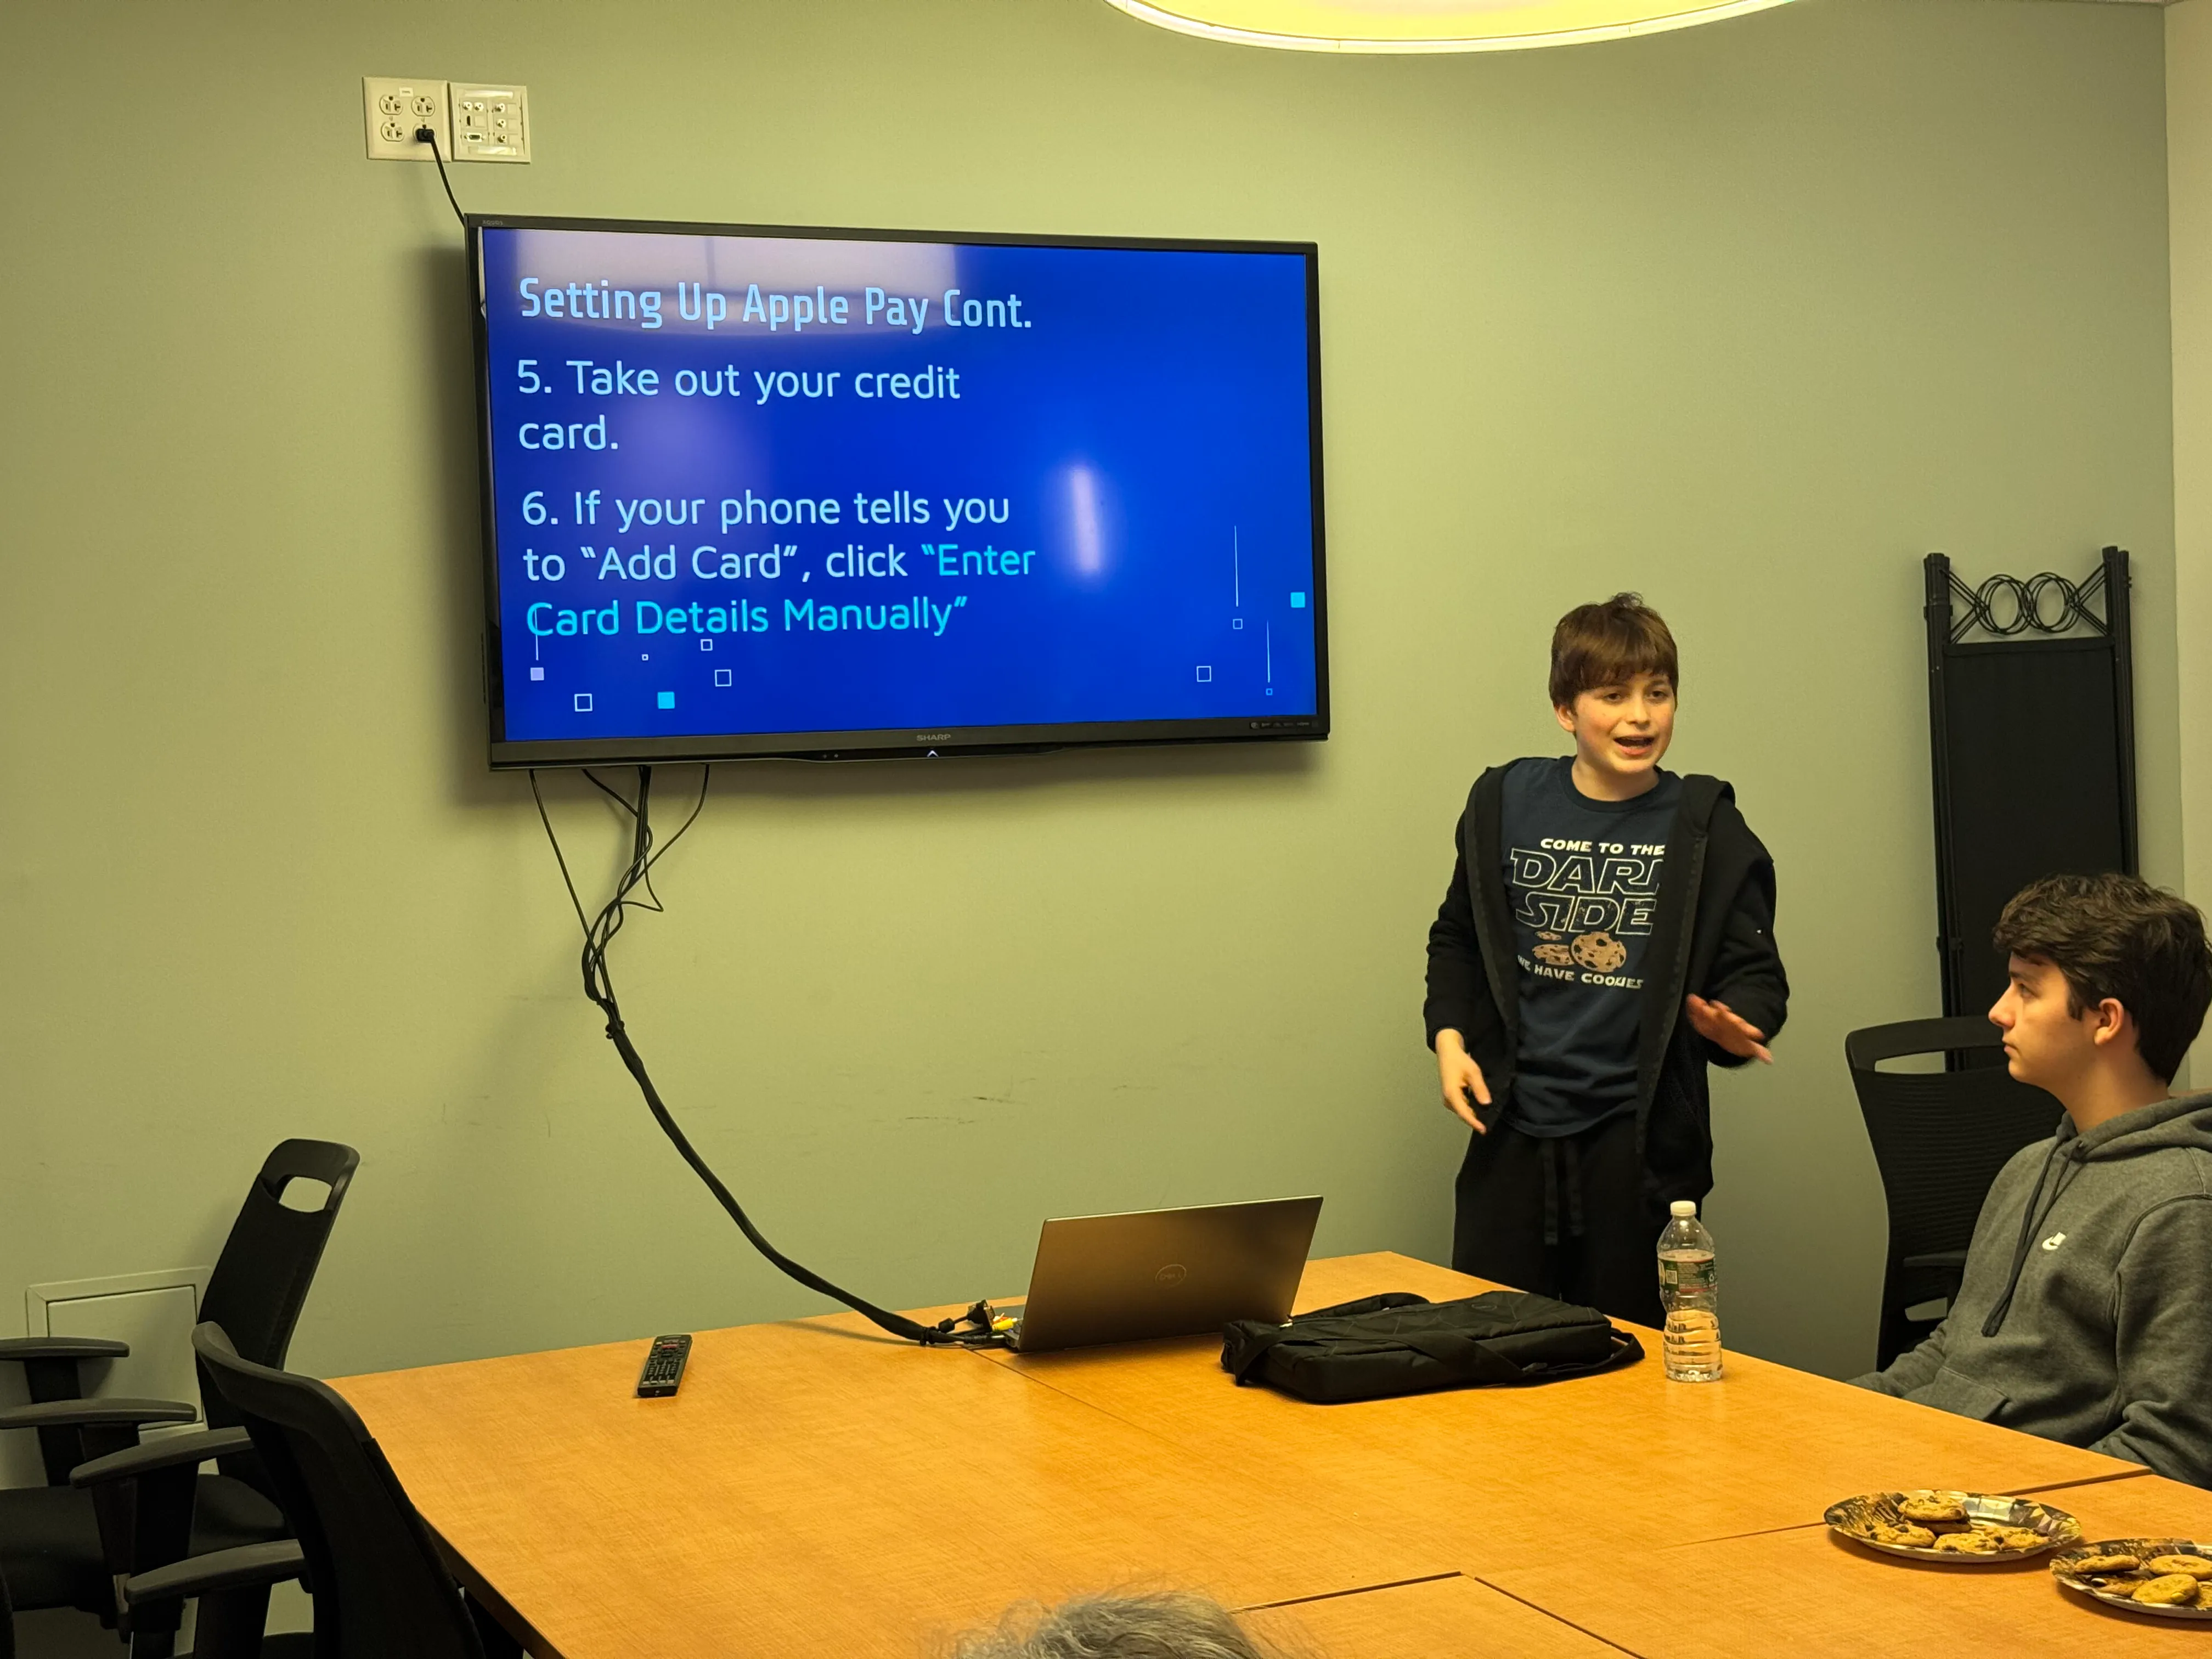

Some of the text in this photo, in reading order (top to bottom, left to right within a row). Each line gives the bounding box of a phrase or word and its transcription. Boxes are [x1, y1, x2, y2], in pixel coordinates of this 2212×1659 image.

[519, 277, 1032, 335] Setting Up Apple Pay Cont.
[518, 359, 961, 406] 5. Take out your credit
[518, 414, 619, 450] card.
[522, 489, 1009, 535] 6. If your phone tells you
[522, 548, 566, 582] to
[580, 544, 677, 581] “Add
[826, 543, 909, 578] click
[920, 544, 1036, 577] “Enter
[526, 595, 968, 637] Card Details Manually”
[1540, 838, 1666, 856] COME TO THE
[1515, 891, 1657, 935] SIDE
[1534, 964, 1575, 981] HAVE
